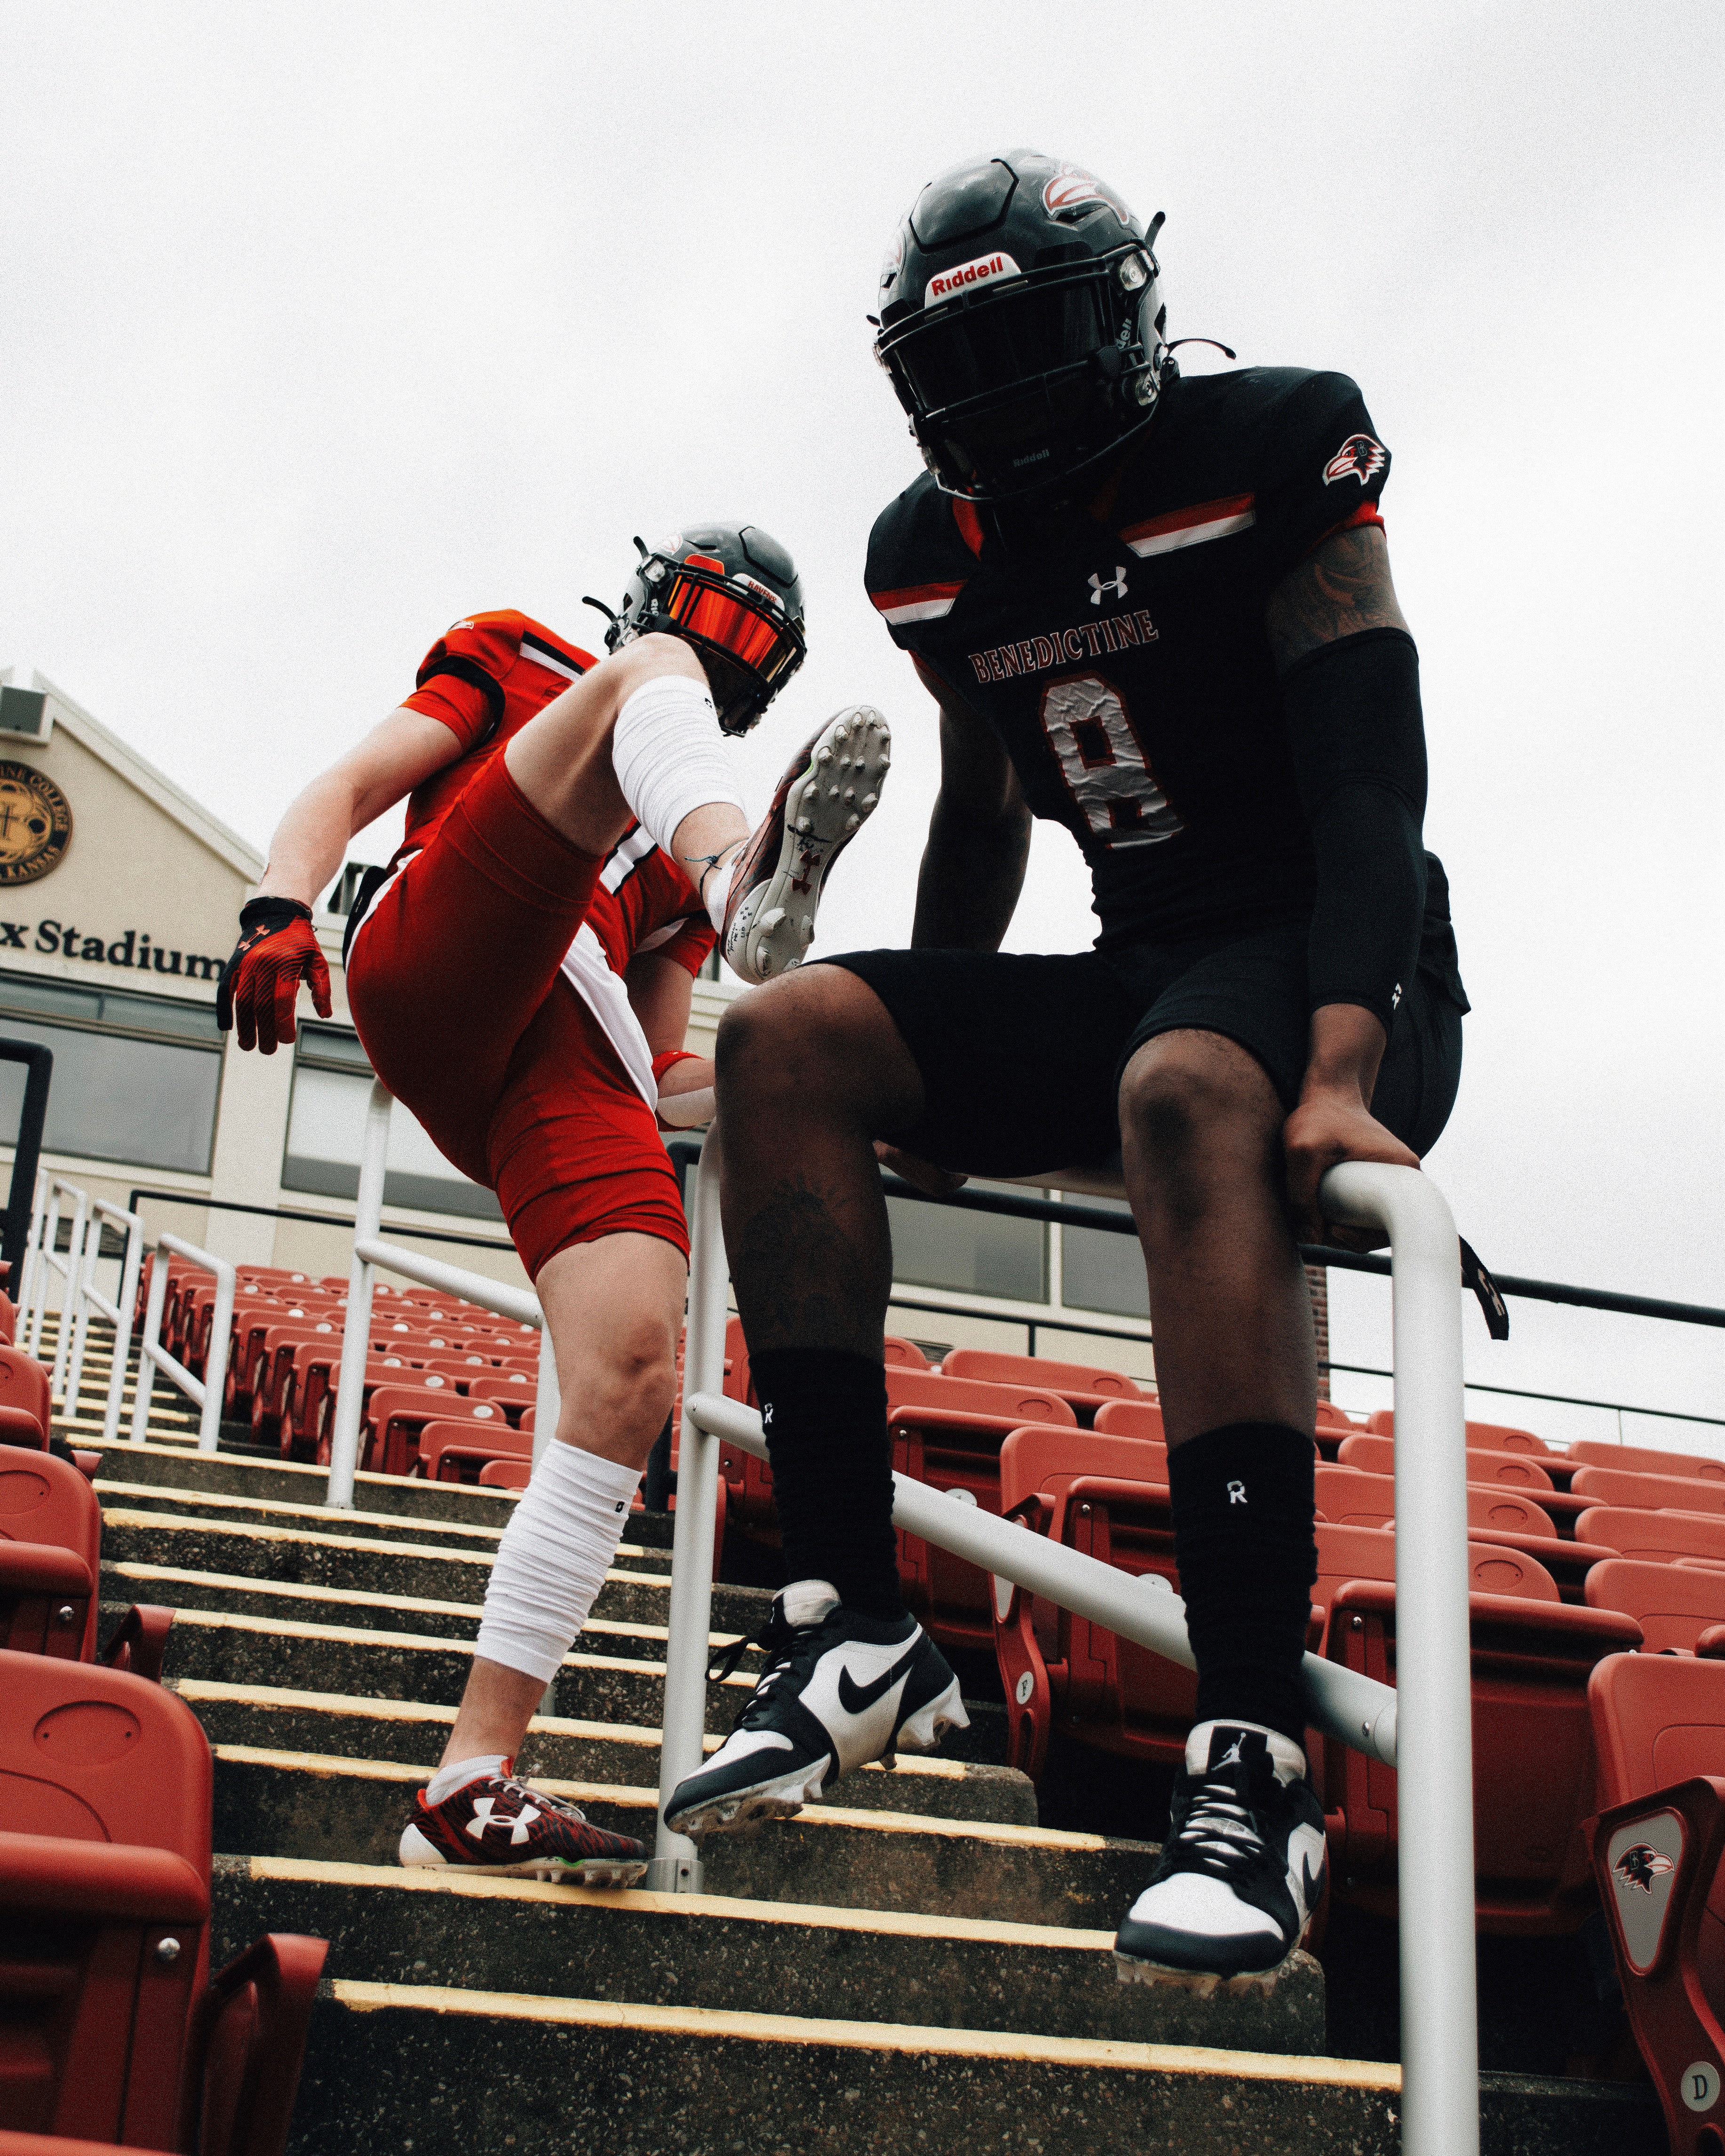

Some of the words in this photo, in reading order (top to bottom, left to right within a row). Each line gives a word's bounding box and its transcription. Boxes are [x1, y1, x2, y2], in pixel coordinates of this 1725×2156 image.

[931, 256, 1003, 296] Riddell
[1013, 449, 1049, 467] Riddell
[748, 580, 777, 603] RAVENS
[968, 610, 1159, 683] BENEDICTINE
[35, 919, 228, 982] Stadium
[1227, 1480, 1248, 1504] R
[1692, 2074, 1709, 2101] D
